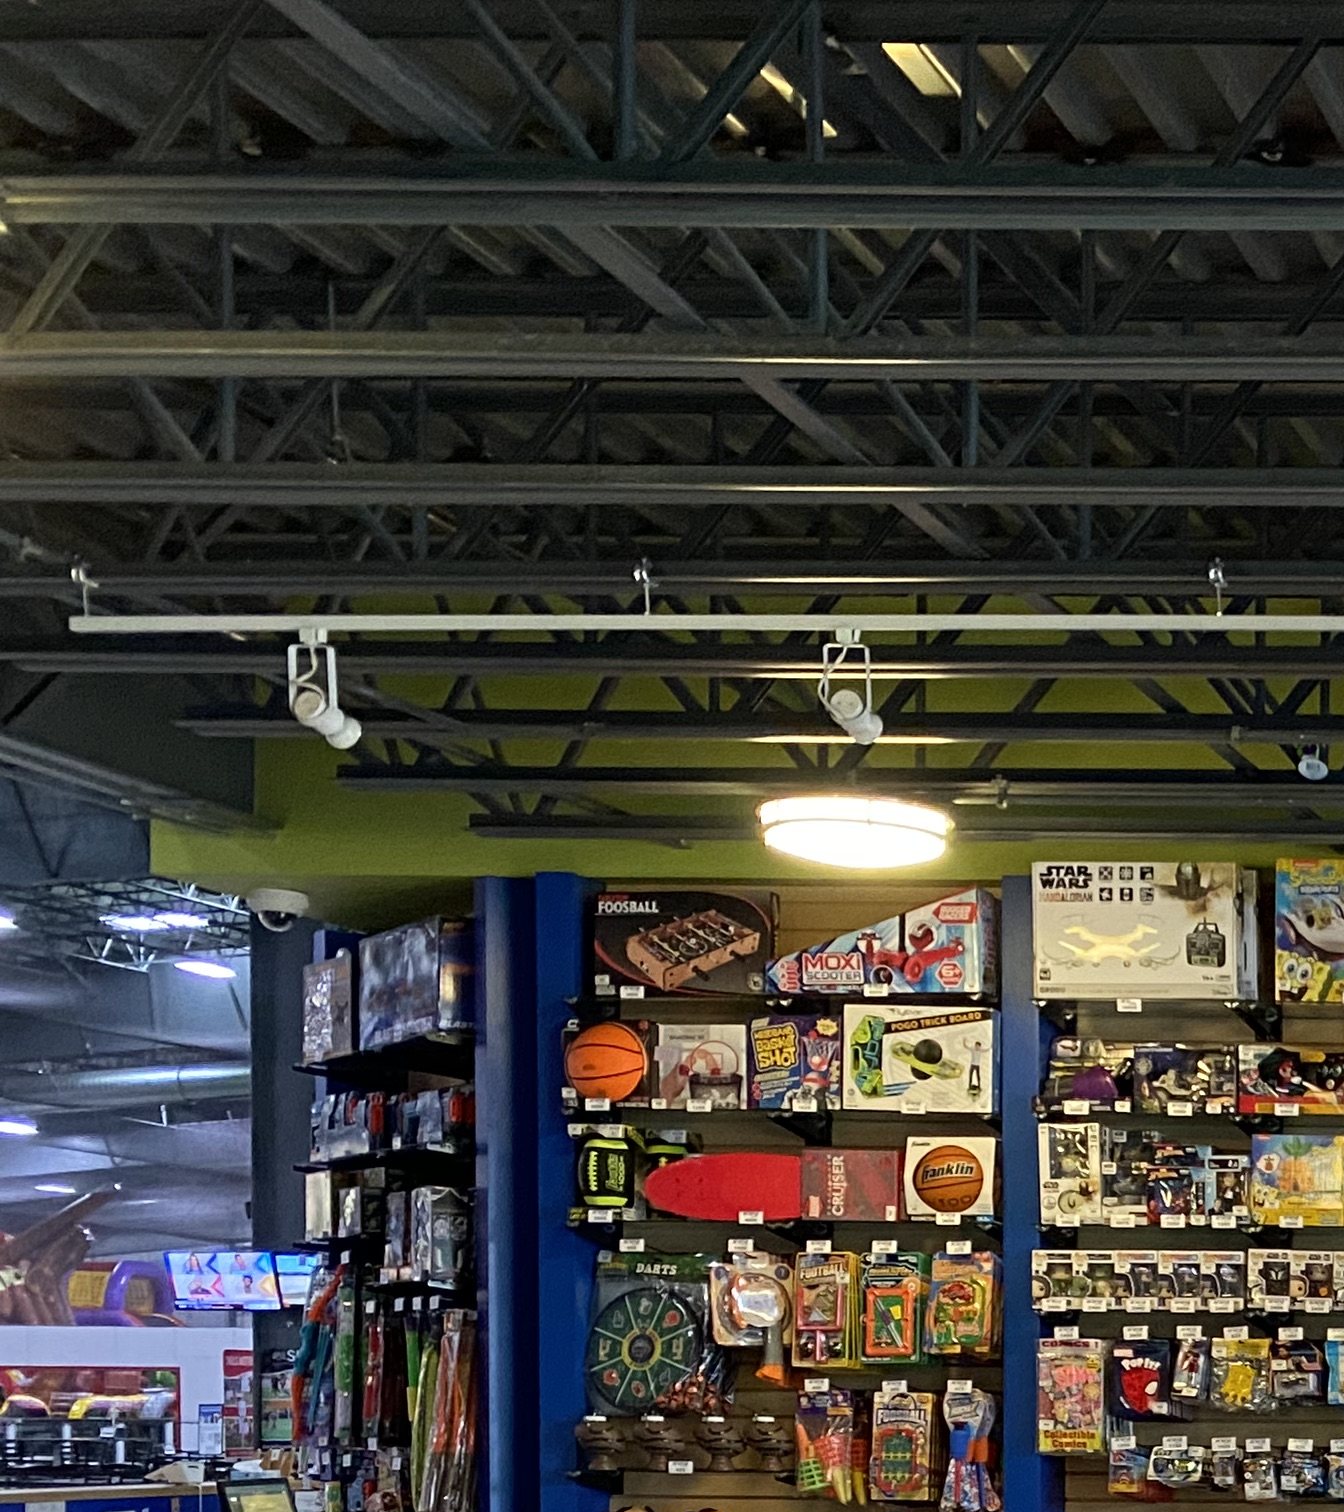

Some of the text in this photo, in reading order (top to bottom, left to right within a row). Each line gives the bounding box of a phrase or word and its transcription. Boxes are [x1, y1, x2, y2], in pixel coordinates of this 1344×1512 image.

[1040, 865, 1093, 878] STAR
[1040, 877, 1093, 890] WARS
[597, 900, 660, 914] FOOSBALL
[805, 971, 861, 982] SCOOTER
[891, 1011, 982, 1031] POGO TRICK BOARD
[832, 1155, 849, 1217] CRUISER
[636, 1263, 677, 1276] DARTS
[1043, 1430, 1096, 1440] Collectible
